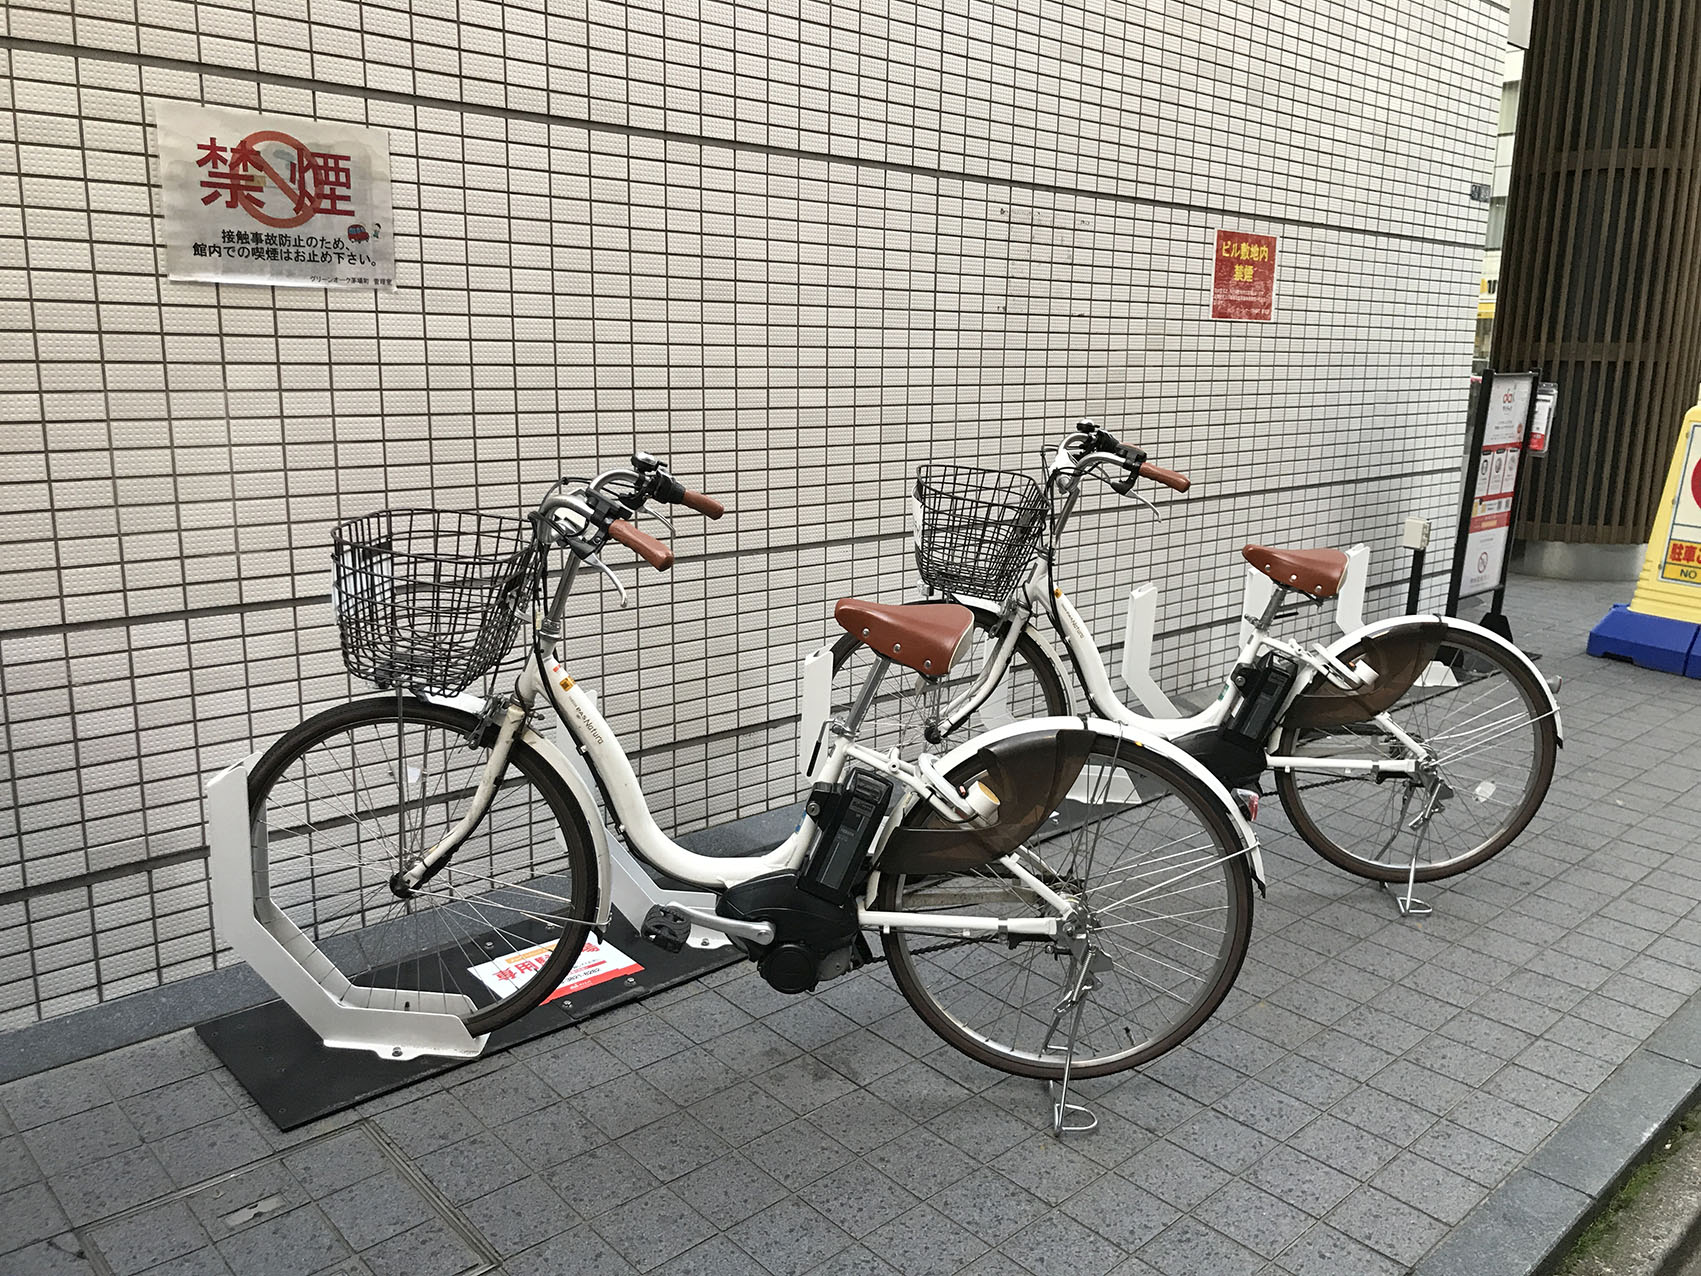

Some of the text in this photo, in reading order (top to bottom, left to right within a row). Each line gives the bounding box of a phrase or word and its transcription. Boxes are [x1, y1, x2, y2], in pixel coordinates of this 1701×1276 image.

[195, 137, 355, 217] 禁煙
[222, 229, 352, 253] 接触事故防止のため、
[192, 242, 378, 268] 館内での喫煙はお止め下さい。
[1233, 263, 1254, 282] 禁煙
[1680, 569, 1698, 580] NO
[583, 717, 604, 745] Natura
